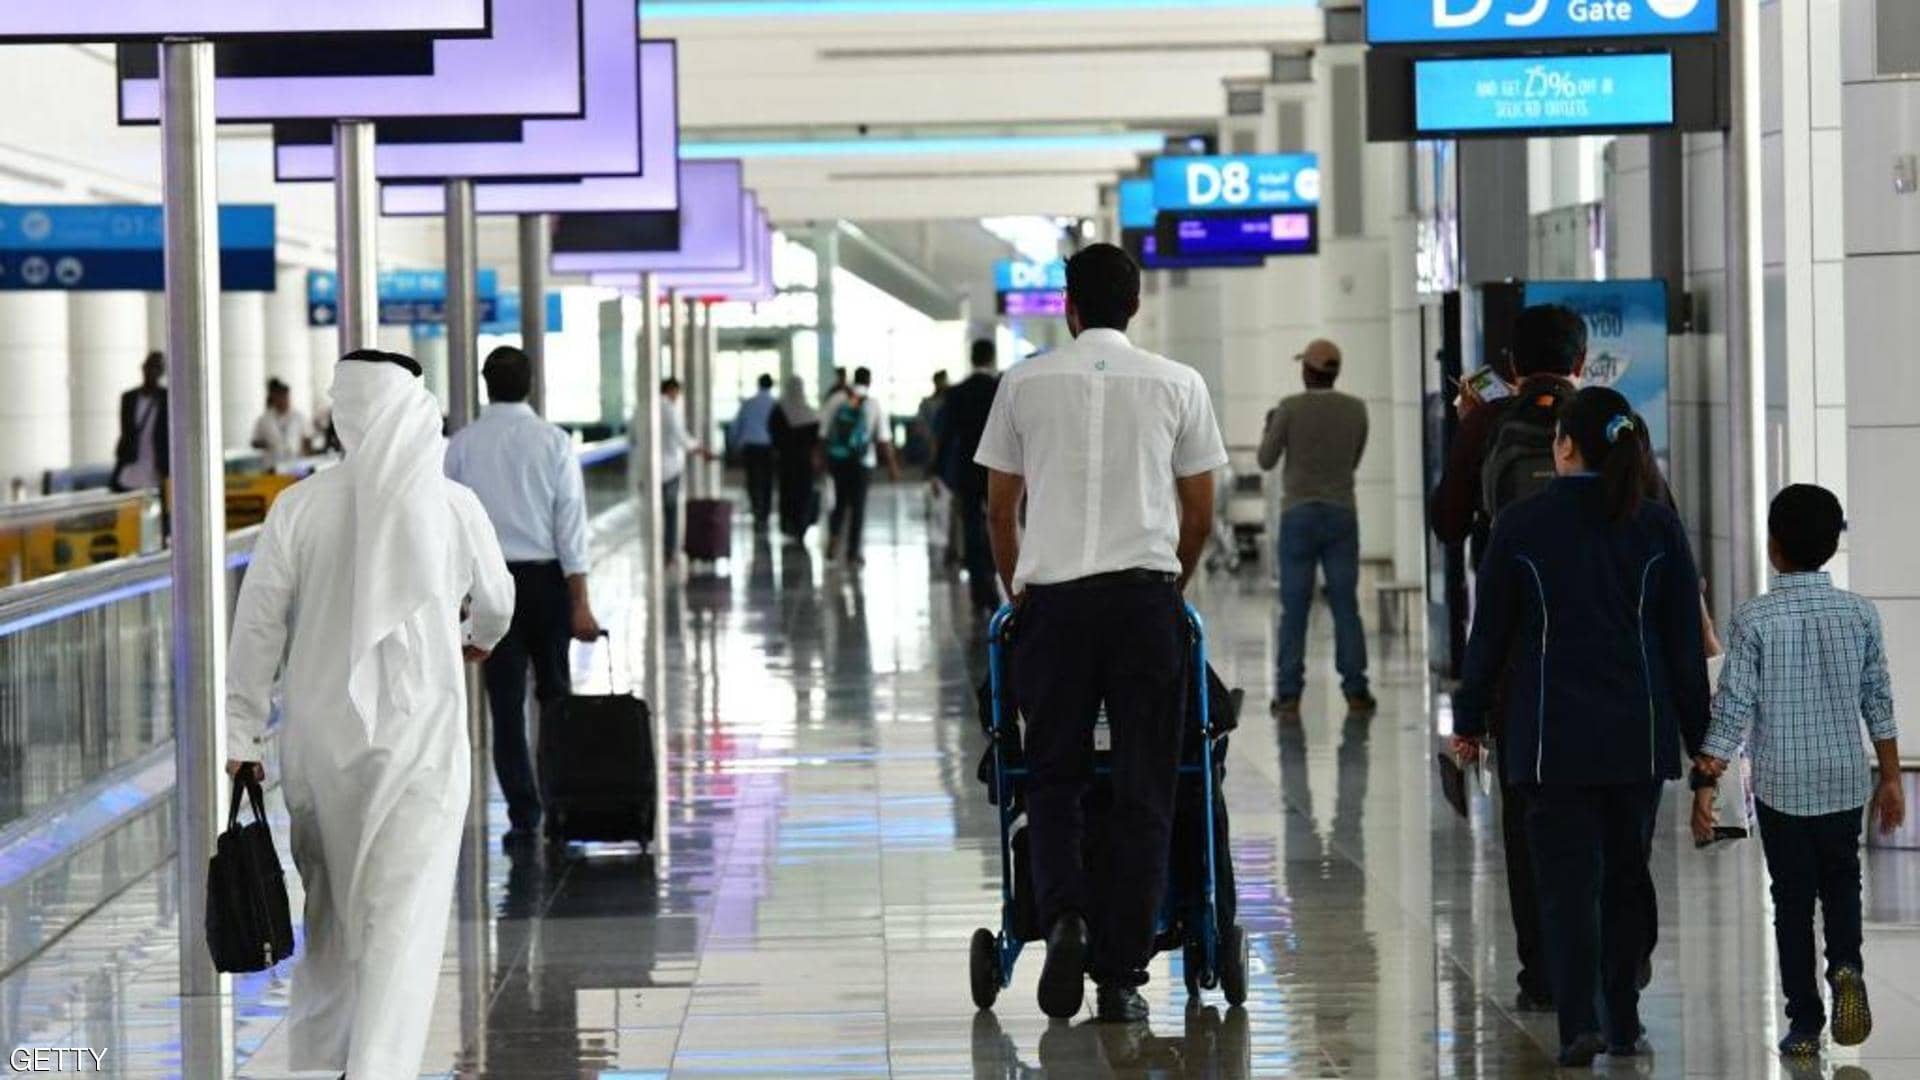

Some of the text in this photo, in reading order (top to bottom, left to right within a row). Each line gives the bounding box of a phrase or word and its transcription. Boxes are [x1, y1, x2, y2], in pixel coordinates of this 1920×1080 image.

[1567, 0, 1632, 22] Gate
[1186, 161, 1251, 205] D8
[1589, 314, 1623, 338] YOU
